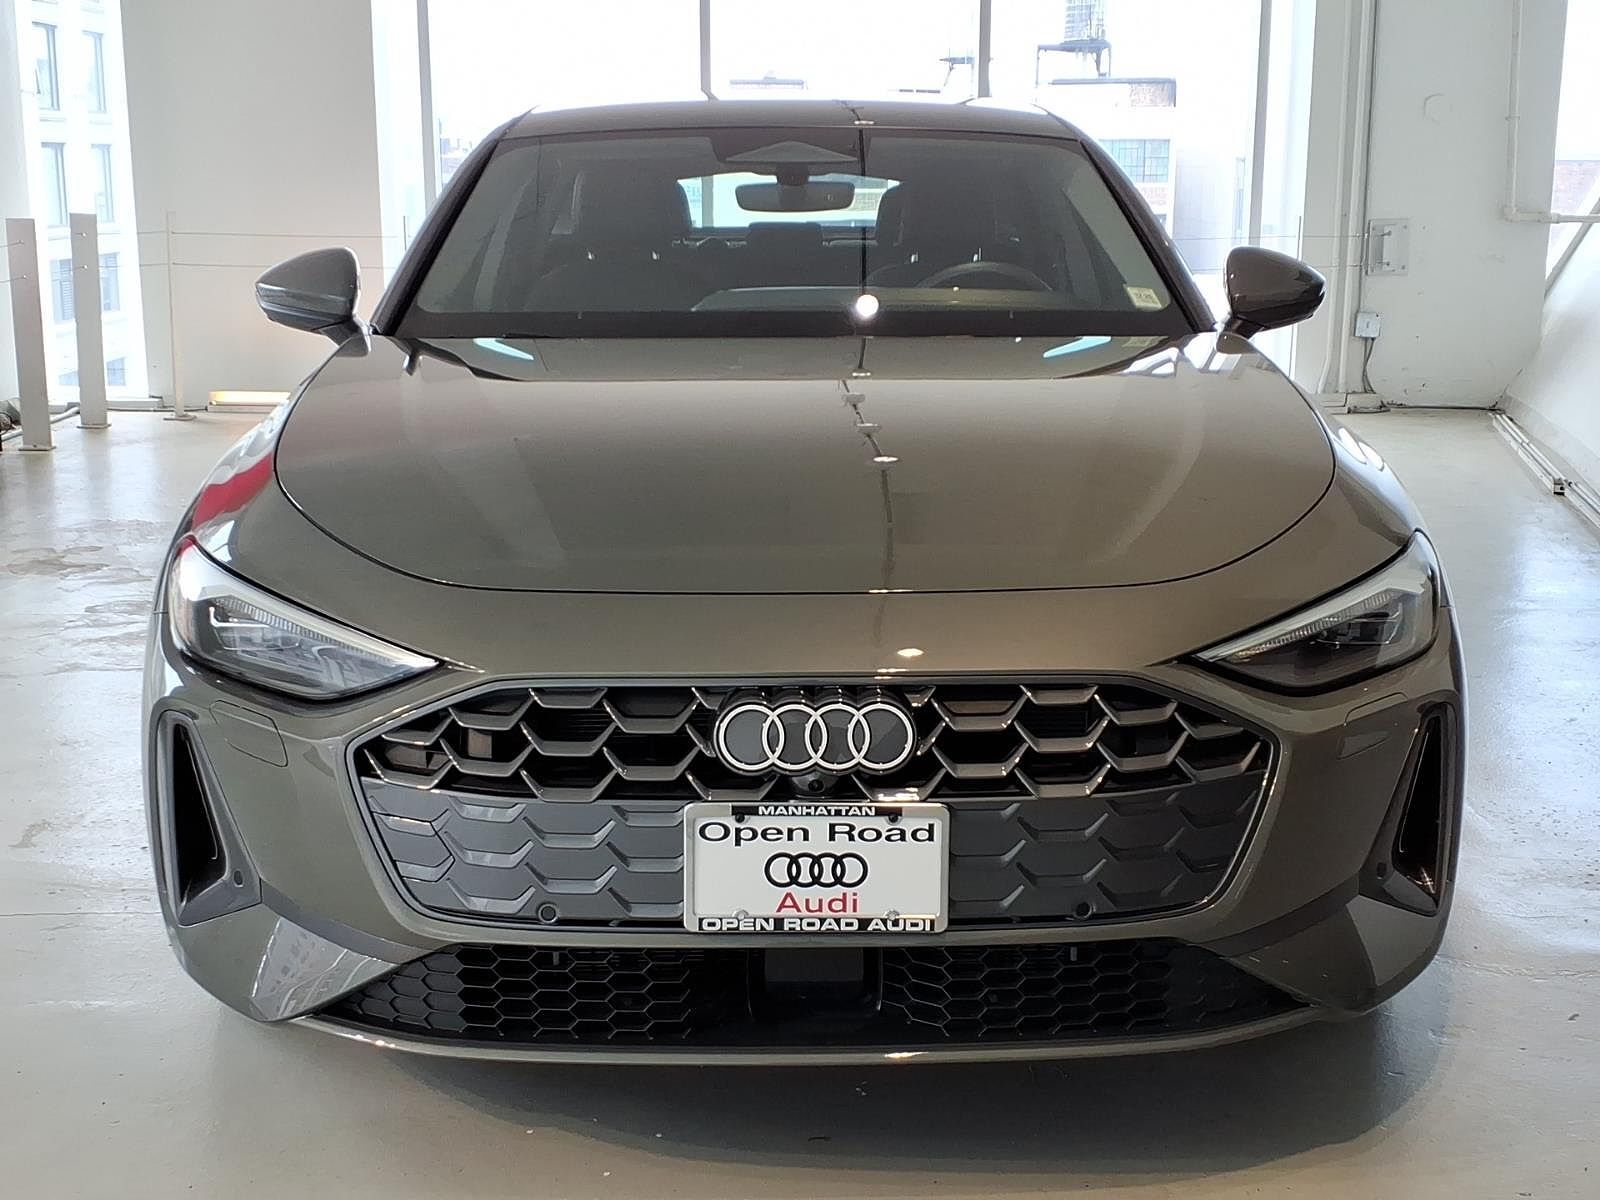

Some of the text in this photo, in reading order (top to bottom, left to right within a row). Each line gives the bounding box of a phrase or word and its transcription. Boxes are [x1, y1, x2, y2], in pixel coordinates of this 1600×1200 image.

[758, 806, 876, 816] MANHATTAN
[699, 822, 935, 847] Open Road
[776, 892, 860, 913] Audi
[702, 919, 931, 931] OPEN ROAD AUDI
